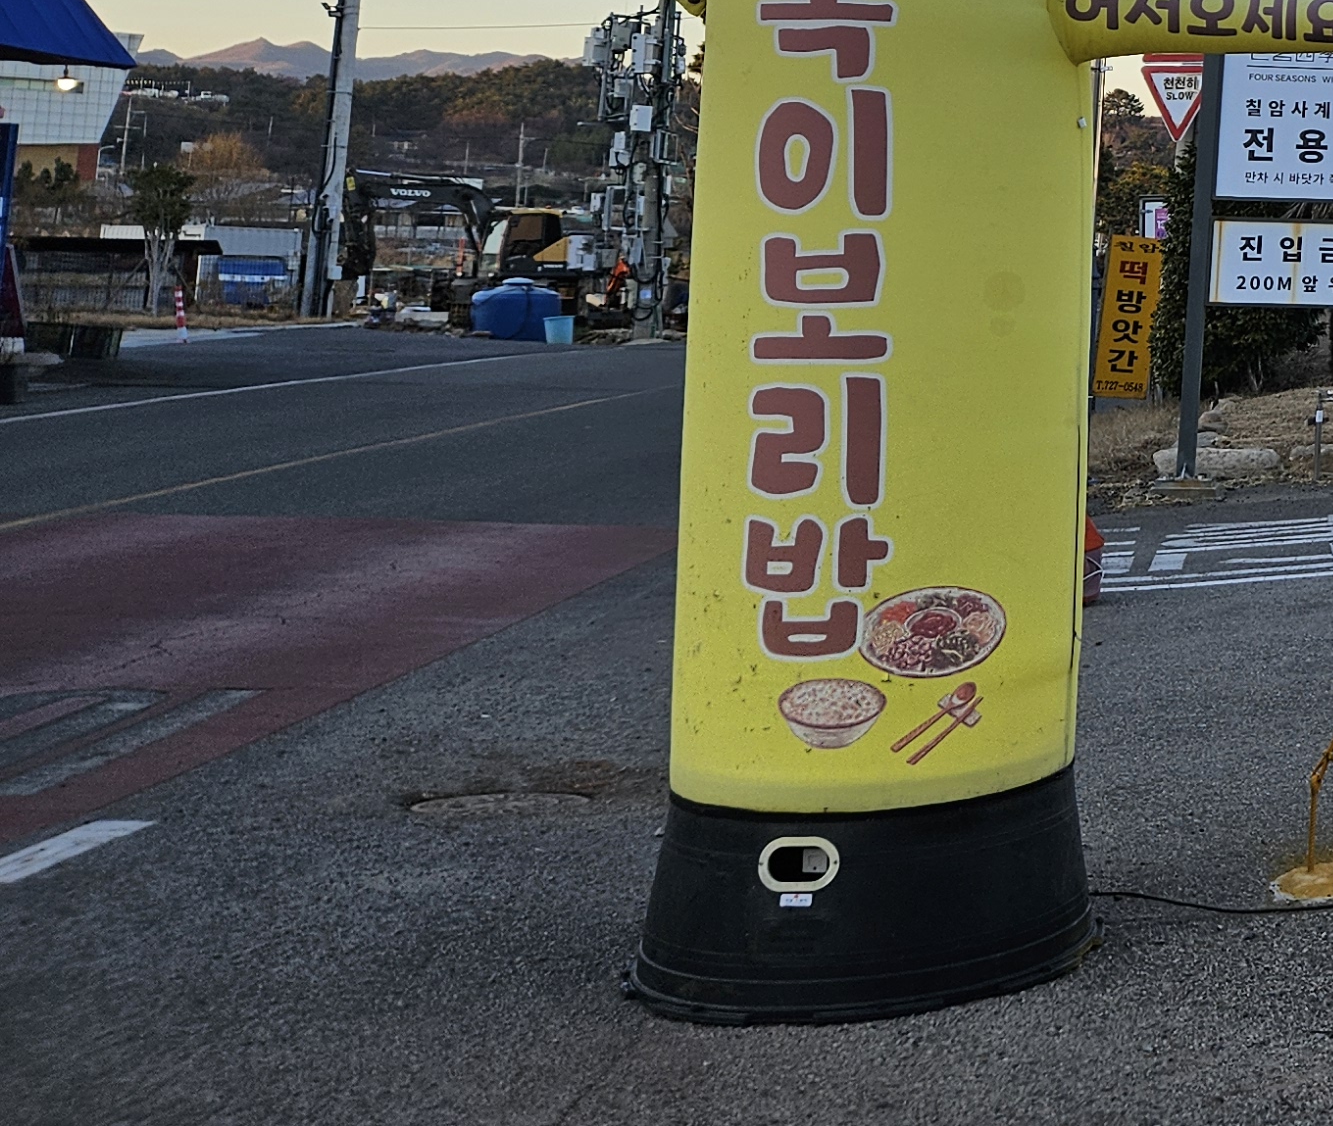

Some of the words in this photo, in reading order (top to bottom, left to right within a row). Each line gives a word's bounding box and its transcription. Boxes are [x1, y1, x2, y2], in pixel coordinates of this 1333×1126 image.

[1163, 76, 1198, 90] 천천히
[1248, 73, 1274, 82] FOUR
[1275, 74, 1317, 83] SEASONS
[1166, 91, 1195, 101] SLOW
[1245, 98, 1332, 120] 칠암사계
[1244, 171, 1269, 185] 만차
[1273, 171, 1285, 185] 시
[1288, 172, 1325, 186] 바닷가
[390, 187, 432, 197] VOLVO
[1235, 274, 1293, 291] 200M
[1301, 274, 1319, 294] 앞
[1107, 259, 1149, 374] 떡방앗간
